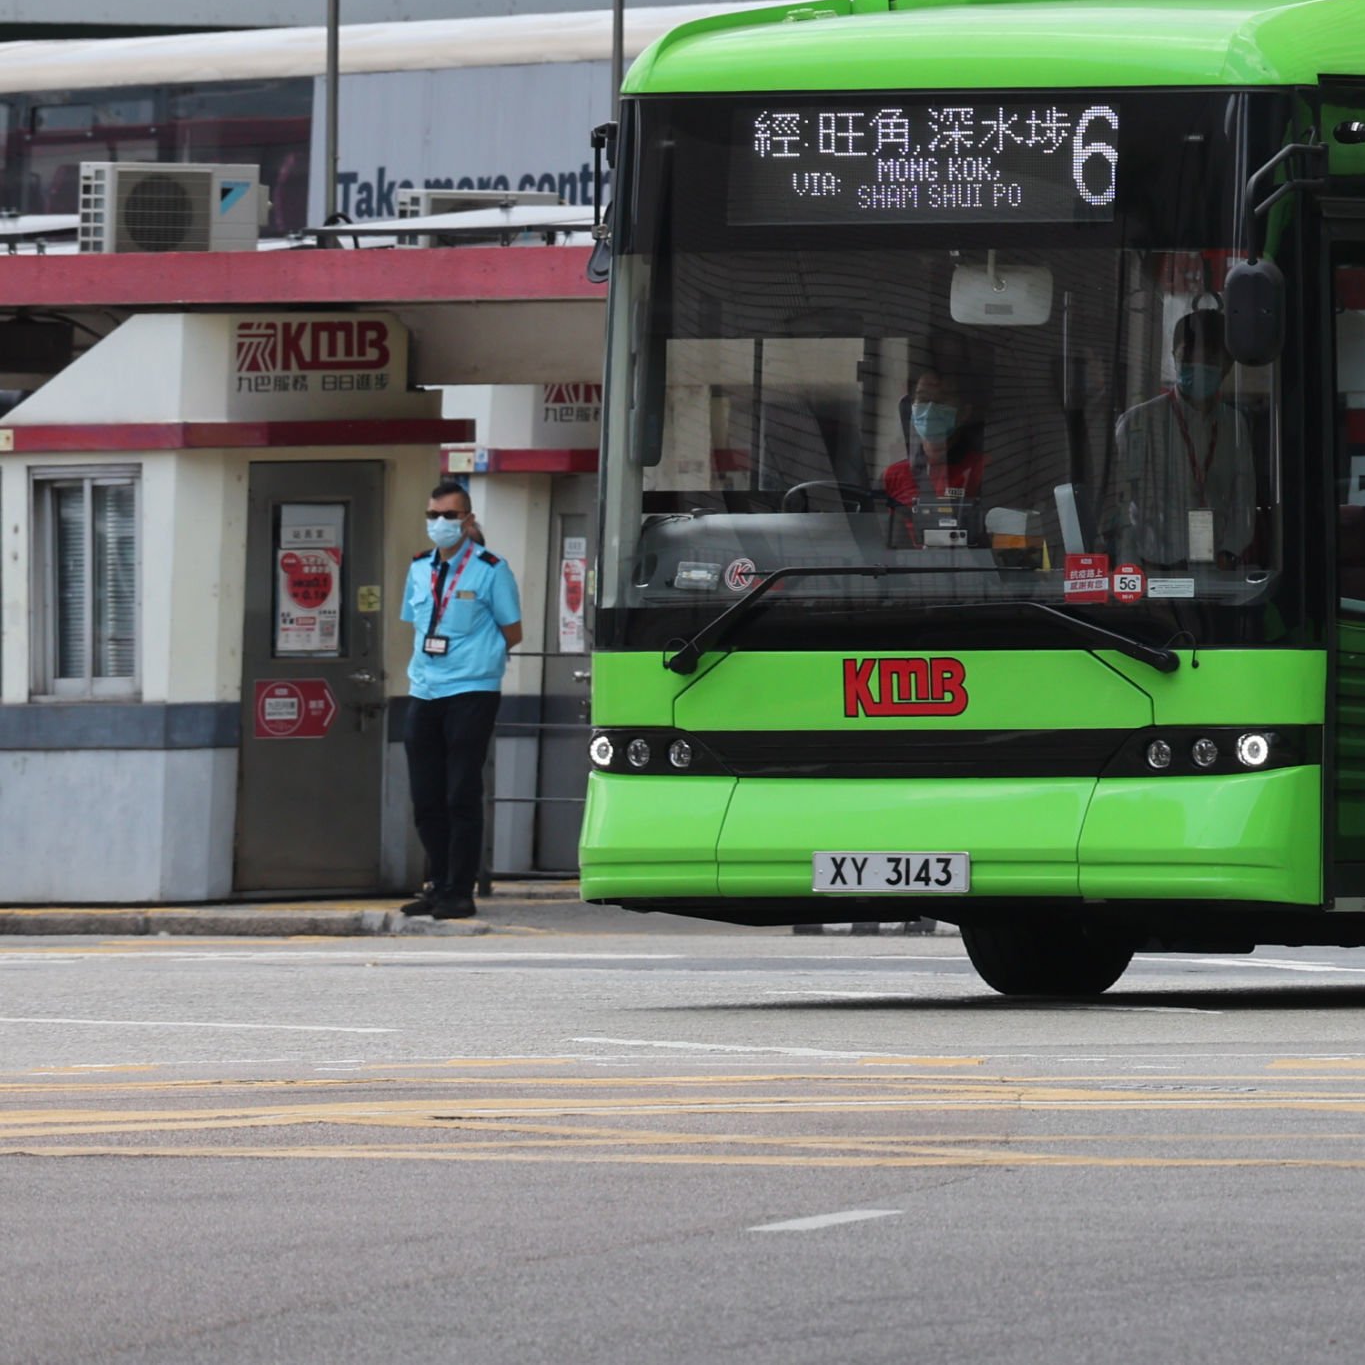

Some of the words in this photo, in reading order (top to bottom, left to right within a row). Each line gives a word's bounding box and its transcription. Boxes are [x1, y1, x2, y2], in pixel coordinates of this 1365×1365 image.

[877, 158, 938, 182] MONG
[948, 157, 1001, 182] KOK,
[1072, 105, 1118, 206] 6
[793, 173, 841, 196] VIA:
[857, 185, 918, 209] SHAM
[928, 184, 982, 208] SHUI
[993, 183, 1022, 207] PO
[282, 321, 390, 371] KMB
[1119, 577, 1136, 590] 5G
[843, 657, 968, 718] KMB
[829, 857, 867, 886] XY
[885, 857, 953, 887] 3143
